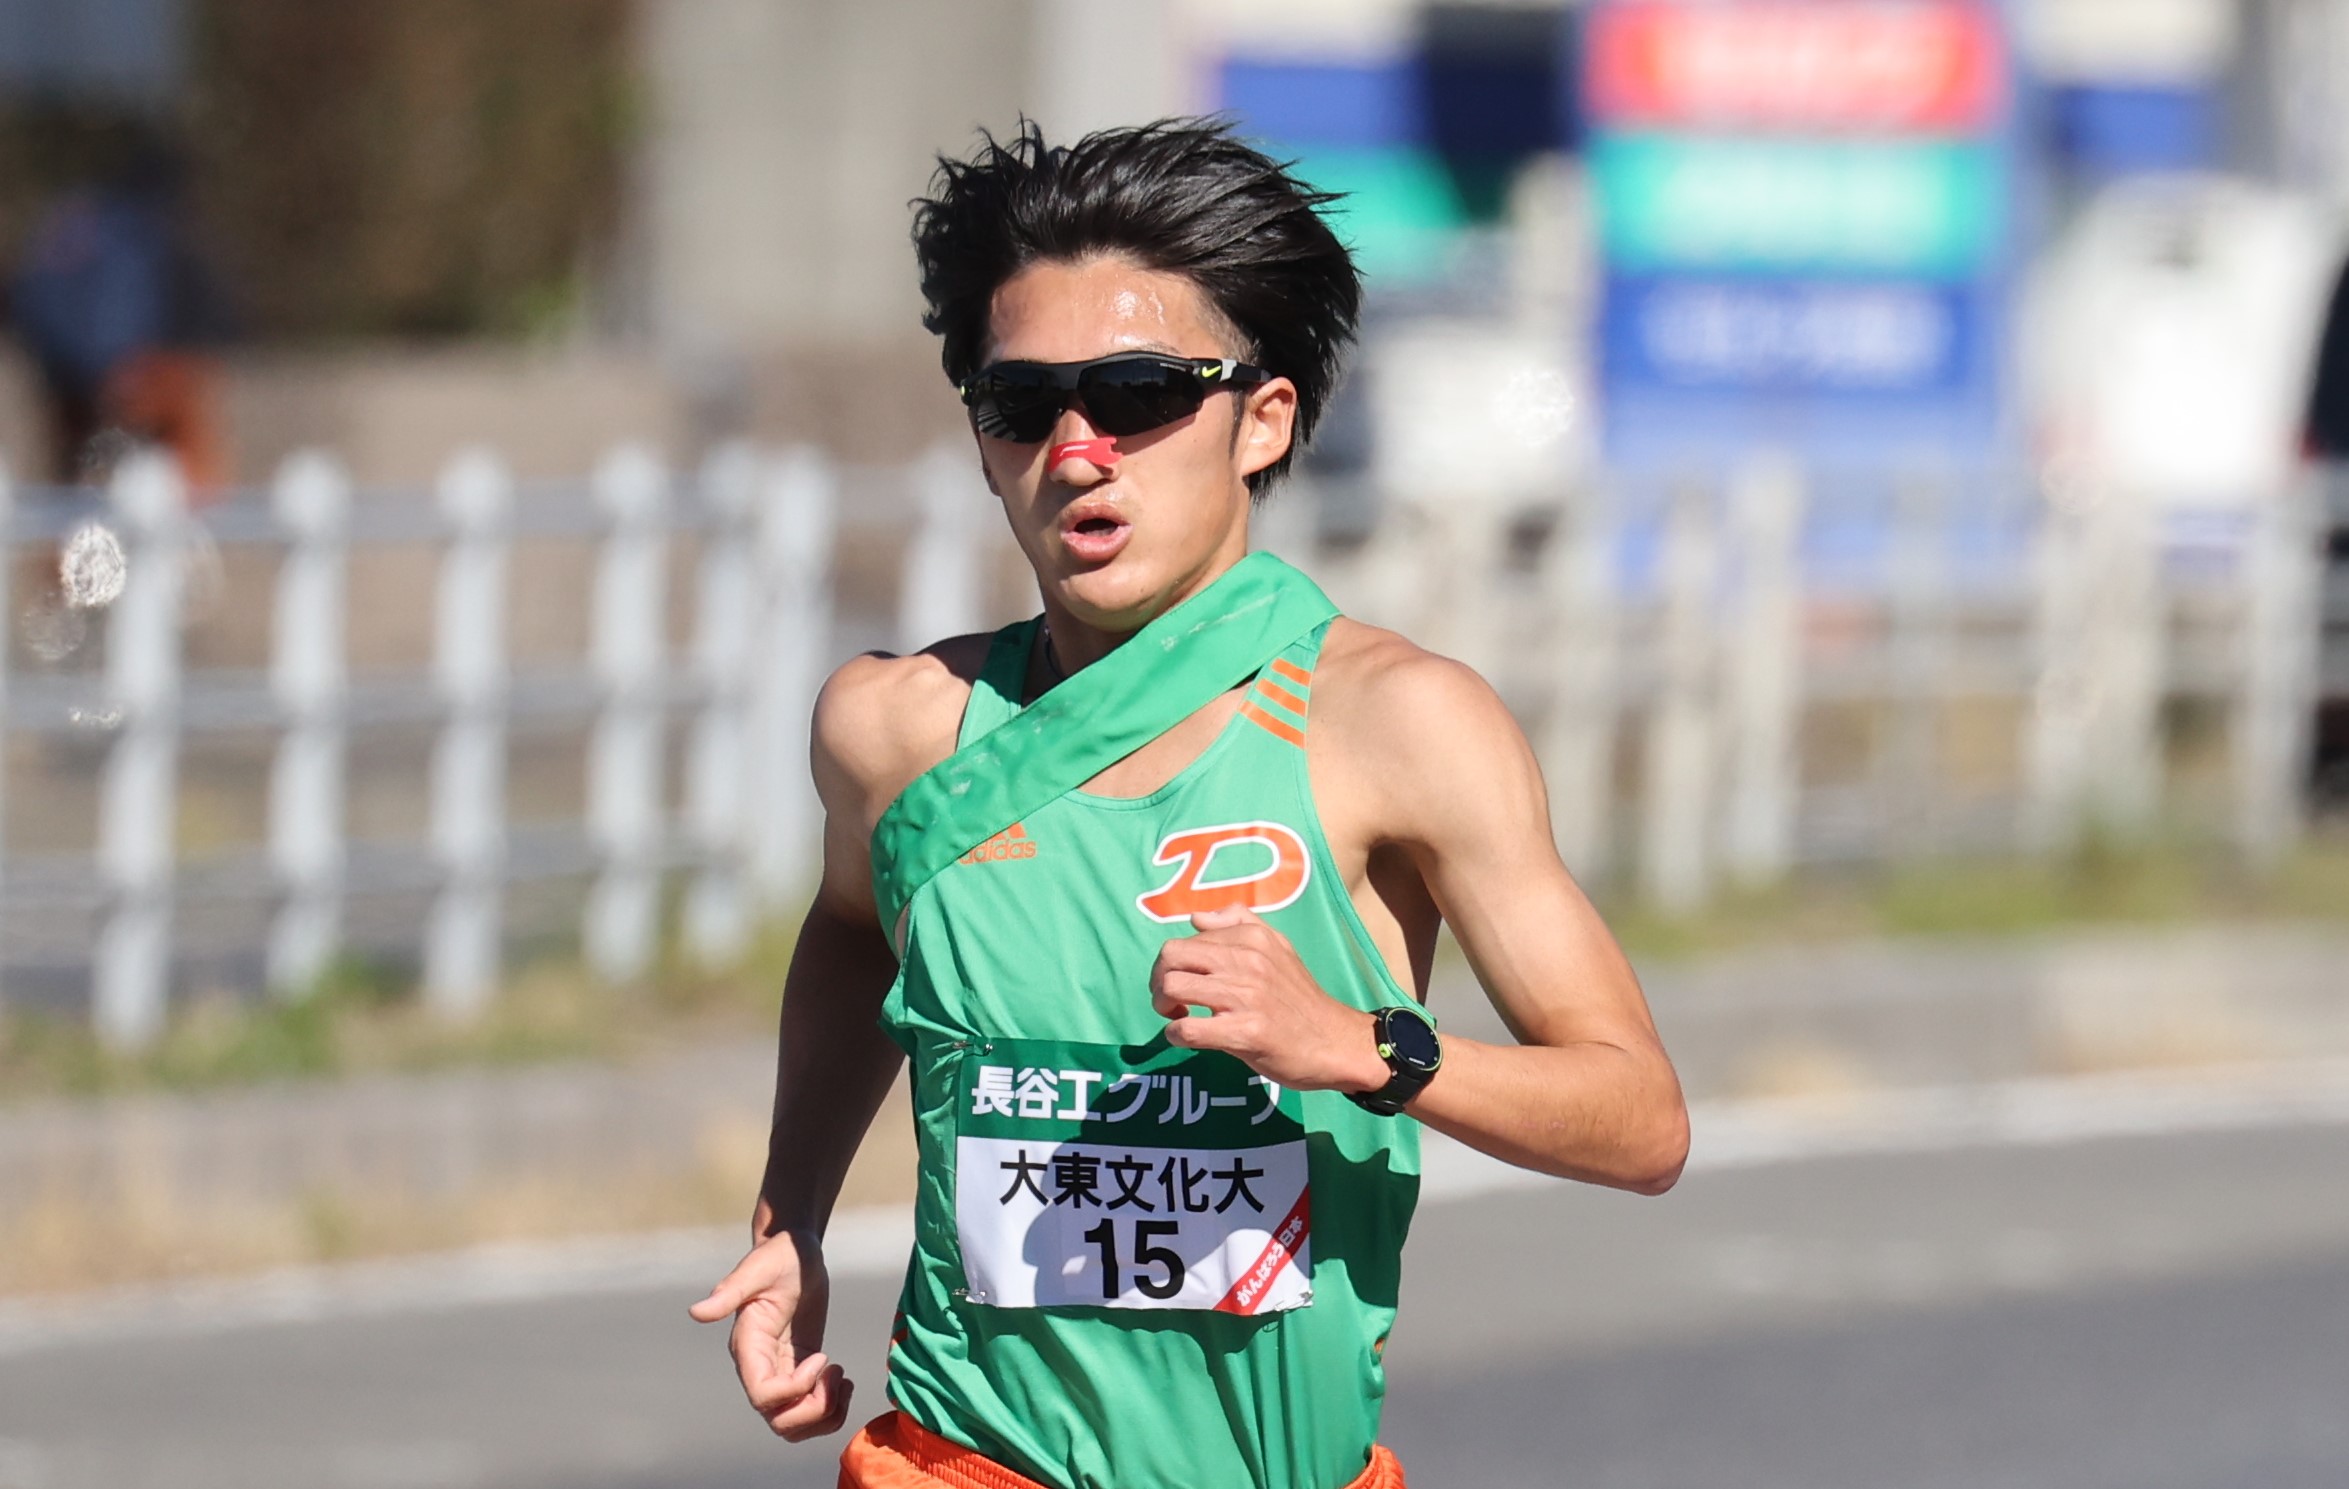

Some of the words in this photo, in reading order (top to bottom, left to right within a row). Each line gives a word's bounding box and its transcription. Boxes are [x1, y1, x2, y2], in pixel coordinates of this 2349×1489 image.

[1136, 820, 1311, 924] D
[999, 1150, 1265, 1214] 大東文化大
[1084, 1217, 1186, 1300] 15
